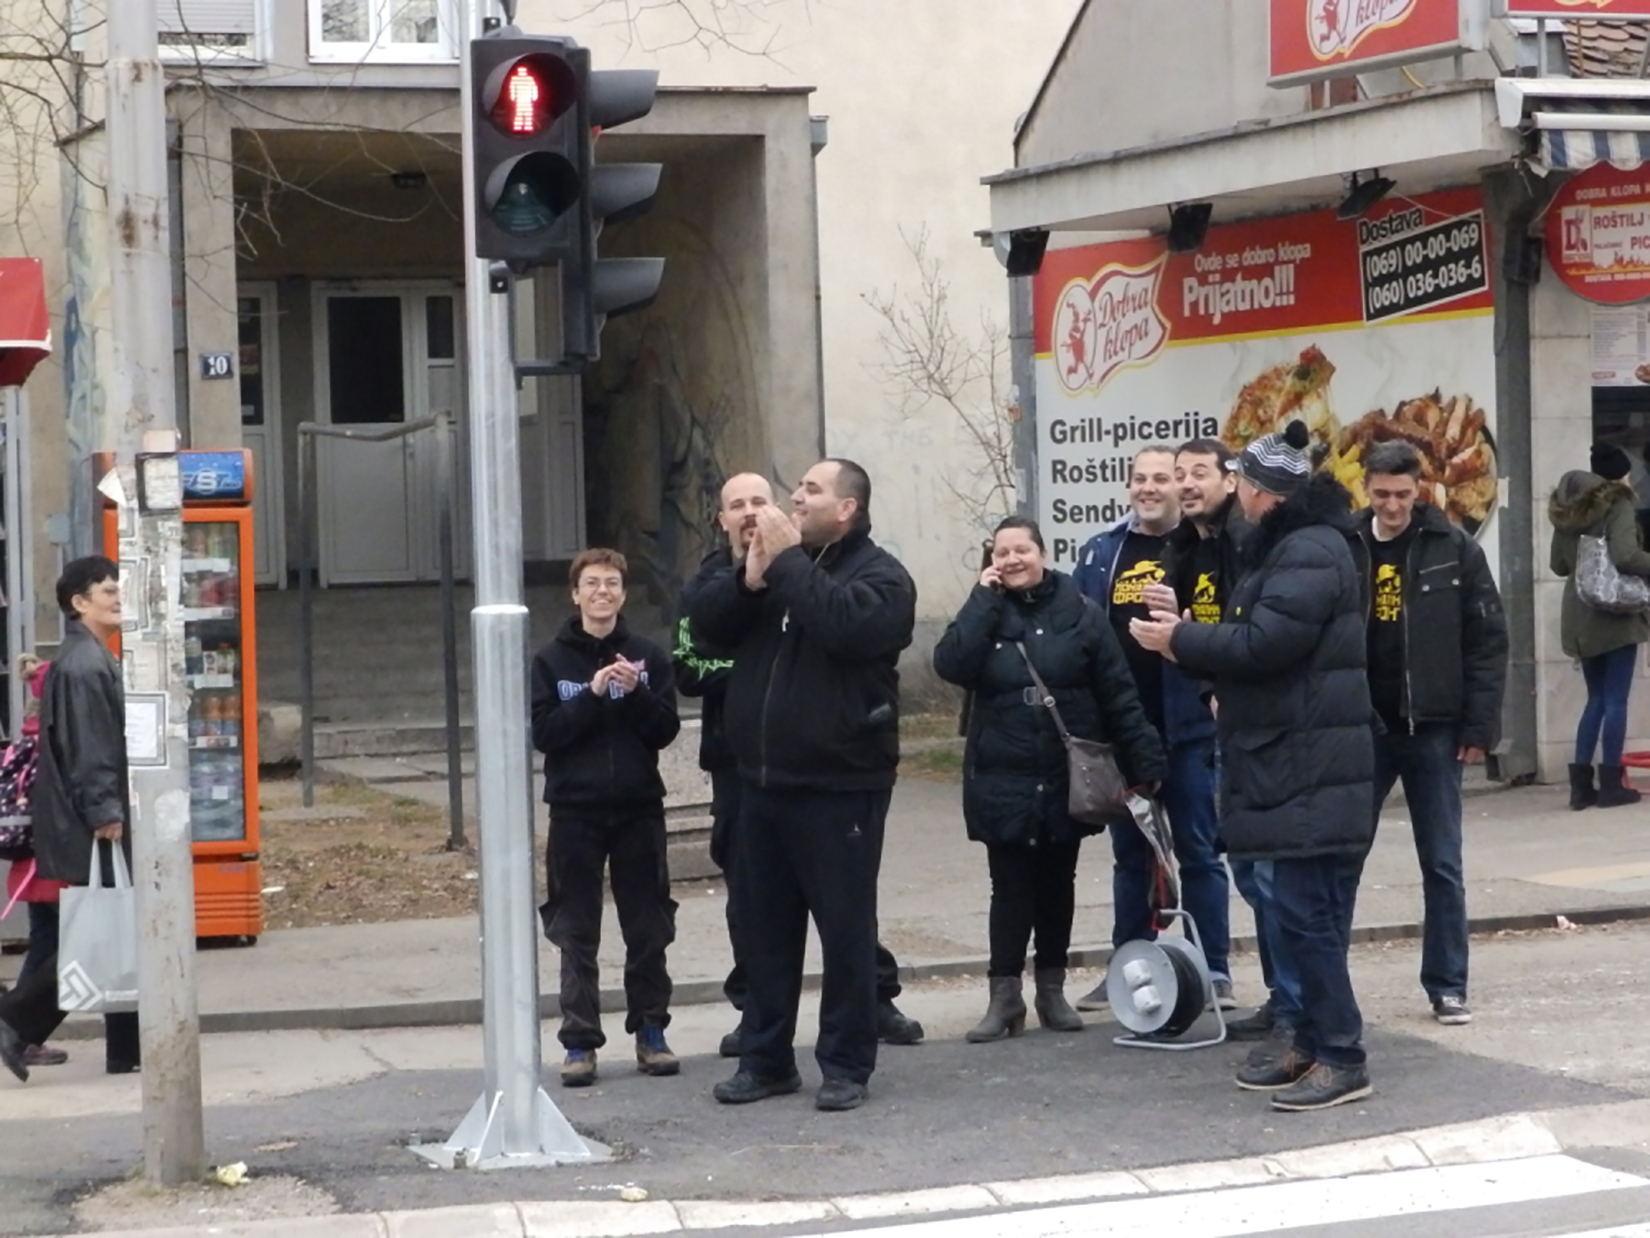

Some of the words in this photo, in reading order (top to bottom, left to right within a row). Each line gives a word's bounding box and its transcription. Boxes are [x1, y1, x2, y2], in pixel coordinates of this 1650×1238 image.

[1356, 0, 1398, 27] klop
[1358, 208, 1424, 245] Dostava
[1593, 211, 1645, 230] ROŠTILJ
[1194, 251, 1223, 273] Ovde
[1225, 253, 1240, 269] se
[1241, 245, 1276, 266] dobro
[1277, 241, 1312, 265] klopa
[1366, 246, 1403, 283] (069)
[1404, 223, 1480, 267] 00-00-069
[1630, 236, 1650, 251] PIC
[1182, 263, 1296, 326] Prijatno!!!
[1368, 278, 1405, 314] (060)
[1406, 255, 1482, 299] 036-036-6
[1098, 281, 1150, 330] Dobra
[1103, 317, 1150, 364] klopa
[207, 355, 228, 376] 10
[1049, 411, 1219, 448] Grill-picerija
[1051, 457, 1133, 489] Roštilj
[1052, 498, 1132, 525] Sendv
[1053, 538, 1078, 563] Pi
[1112, 592, 1143, 604] ФРО
